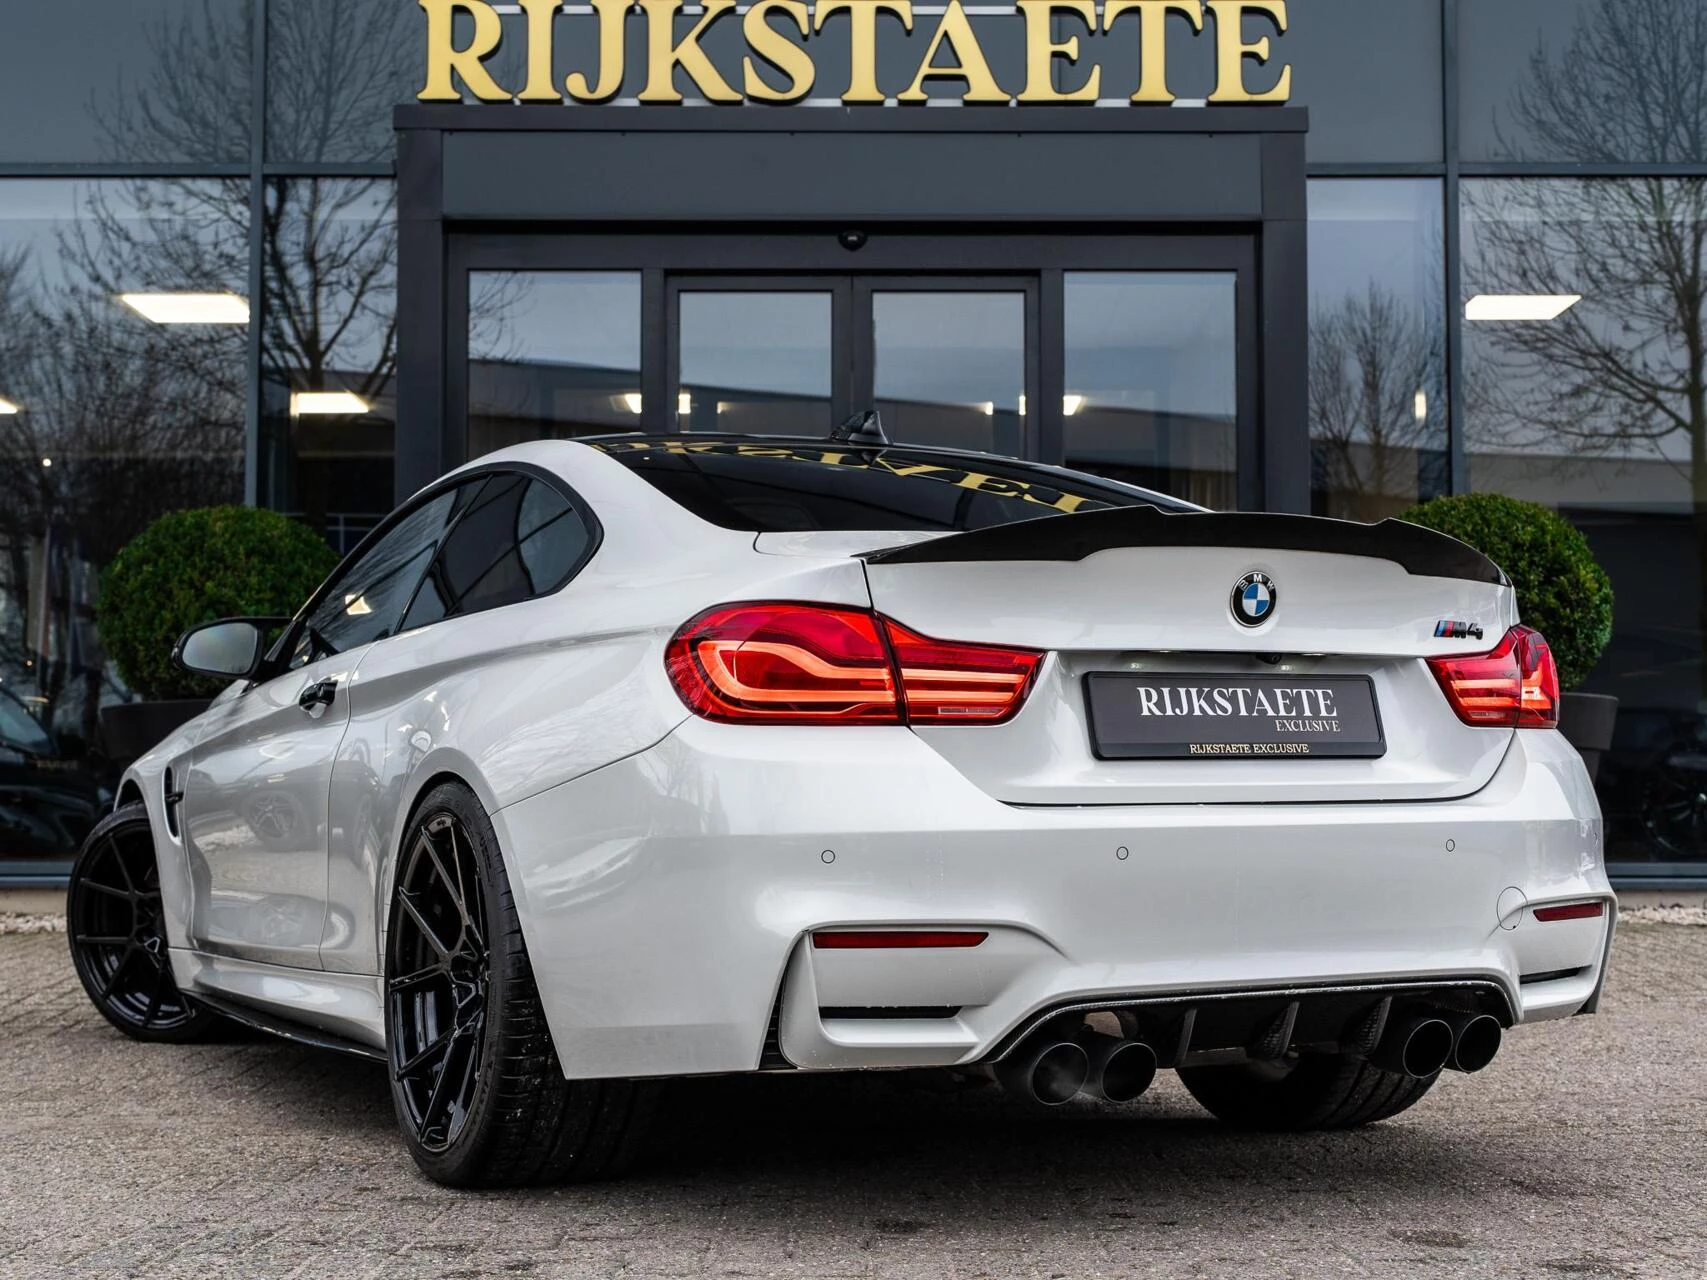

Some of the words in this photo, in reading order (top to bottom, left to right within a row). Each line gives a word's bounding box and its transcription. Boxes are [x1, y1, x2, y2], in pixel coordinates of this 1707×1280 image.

[416, 0, 1292, 101] RIJKSTAETE
[1237, 573, 1275, 592] BMW
[1452, 621, 1483, 640] M4
[1136, 687, 1338, 717] RIJKSTAETE
[1275, 720, 1341, 732] EXCLUSIVE
[1190, 743, 1251, 754] RIJKSTAETE
[1253, 743, 1310, 754] EXCLUSIVE
